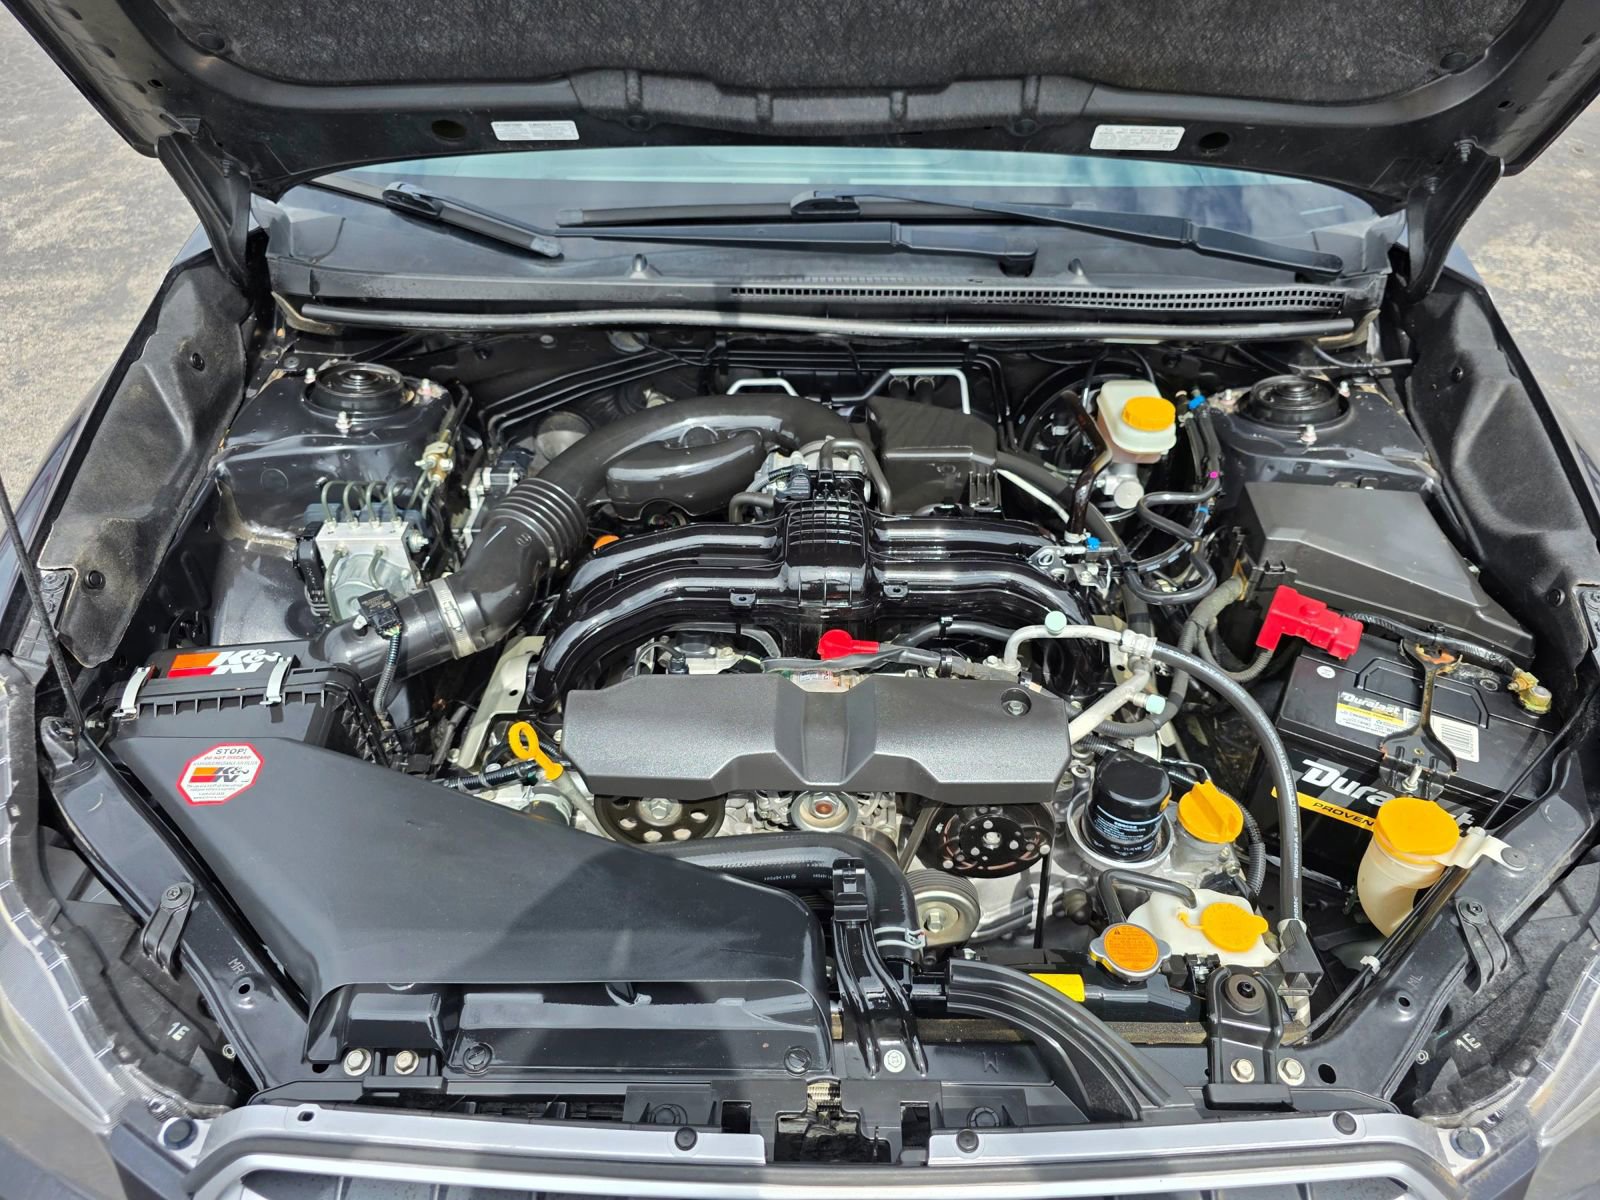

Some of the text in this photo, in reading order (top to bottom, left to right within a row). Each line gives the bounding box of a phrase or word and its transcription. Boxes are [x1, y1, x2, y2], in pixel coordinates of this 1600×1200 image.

[207, 649, 281, 676] K&N
[1340, 691, 1401, 713] Duralast
[212, 766, 250, 783] K&N
[1301, 758, 1475, 828] Durat
[1312, 802, 1375, 827] PROVEN
[228, 958, 245, 974] MR
[167, 1022, 190, 1041] 1E
[1456, 1033, 1482, 1053] 1E
